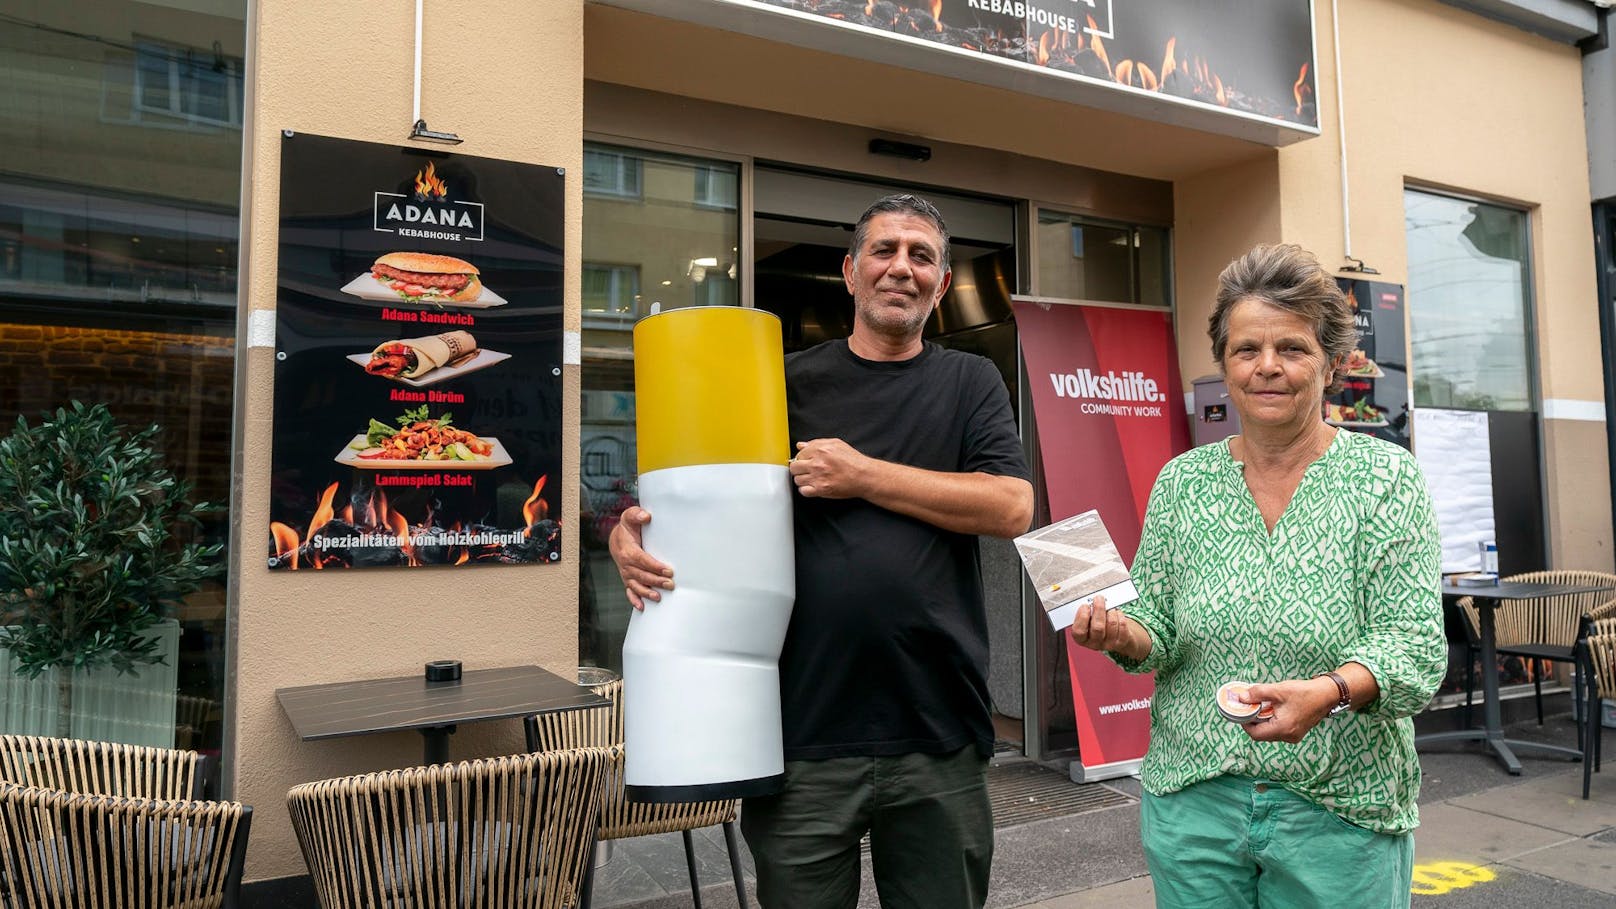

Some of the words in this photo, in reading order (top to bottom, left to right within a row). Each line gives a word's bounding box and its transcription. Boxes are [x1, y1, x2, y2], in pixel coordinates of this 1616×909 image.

[386, 203, 474, 229] ADANA
[398, 228, 461, 241] KEBABHOUSE
[382, 307, 418, 322] Adana
[420, 310, 475, 326] Sandwich
[1049, 368, 1166, 402] volkshilfe.
[390, 388, 426, 401] Adana
[428, 390, 465, 404] Dürüm
[1080, 403, 1132, 417] COMMUNITY
[1133, 406, 1162, 417] WORK
[375, 473, 441, 489] Lammspieß
[443, 474, 473, 486] Salat
[313, 533, 404, 550] Spezialitäten
[408, 534, 436, 547] vom
[438, 532, 525, 547] Holzkohlegrill
